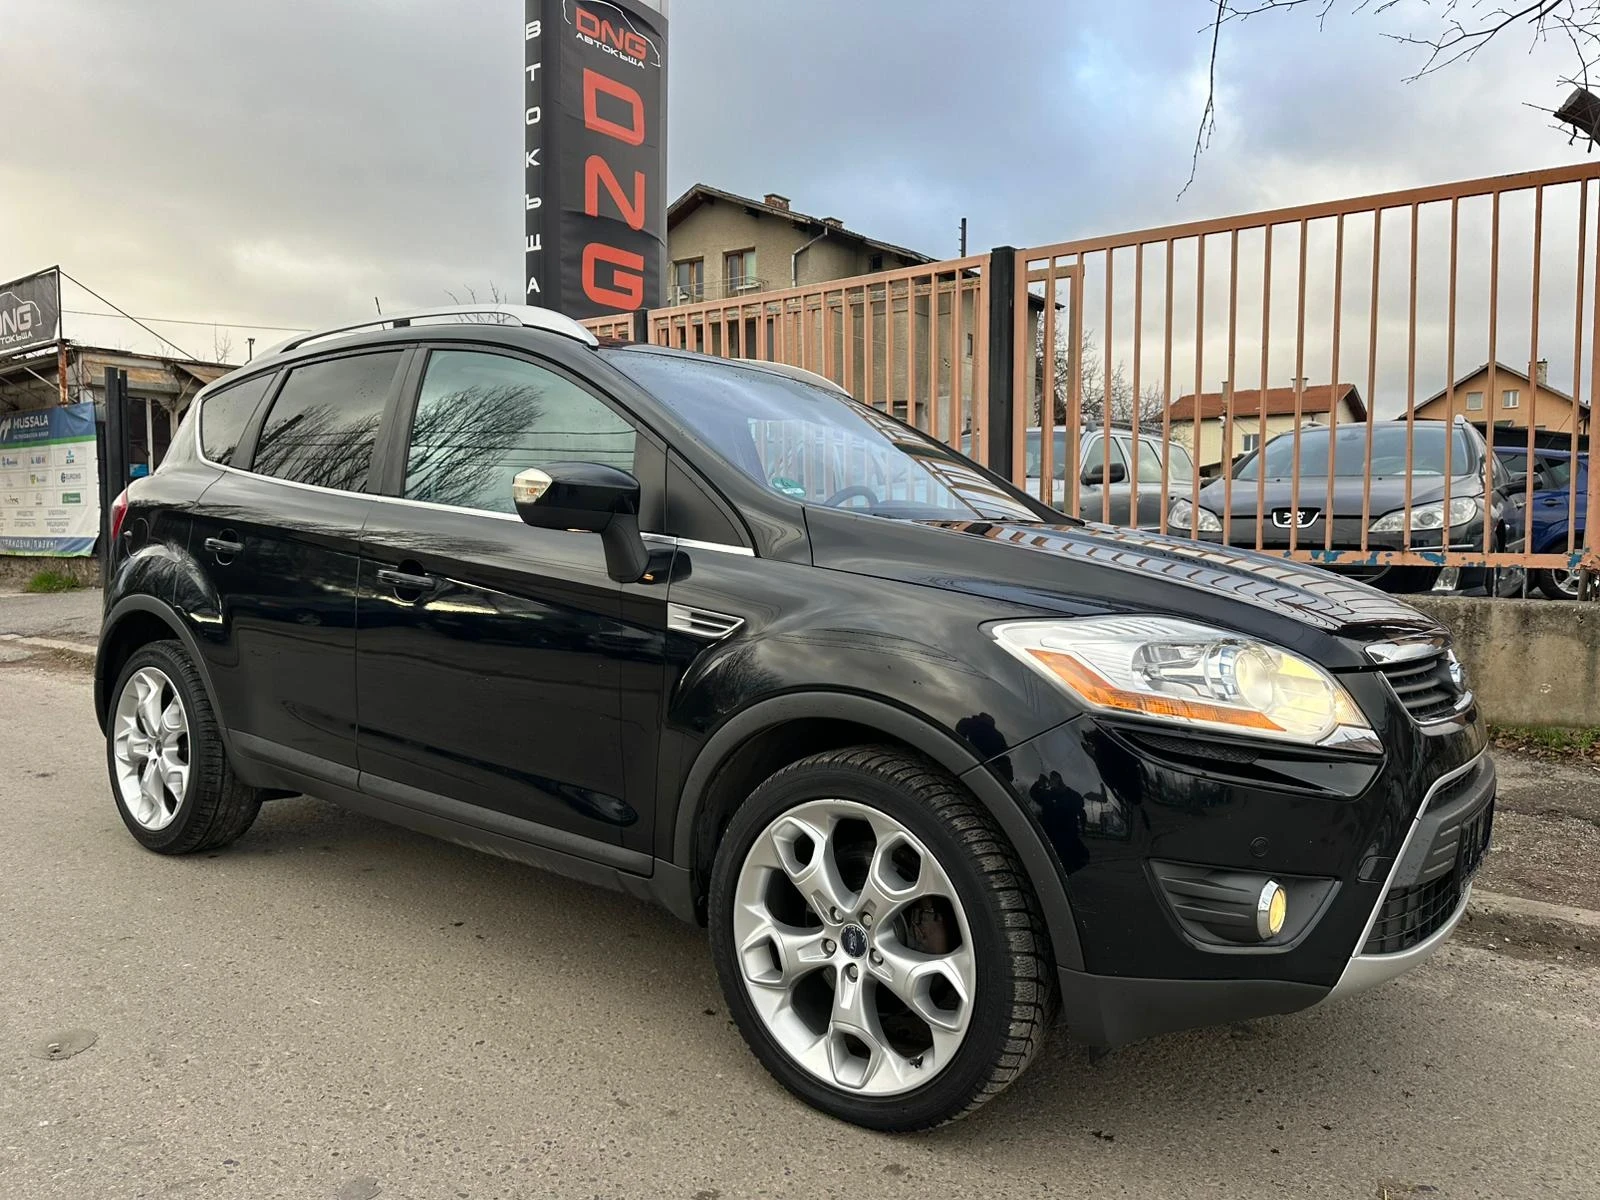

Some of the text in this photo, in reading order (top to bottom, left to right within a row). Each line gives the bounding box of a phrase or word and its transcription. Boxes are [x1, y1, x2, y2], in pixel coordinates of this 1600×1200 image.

[575, 6, 646, 60] DNG
[582, 67, 645, 311] DNG
[0, 303, 32, 336] NG
[13, 414, 49, 429] MUSSALA
